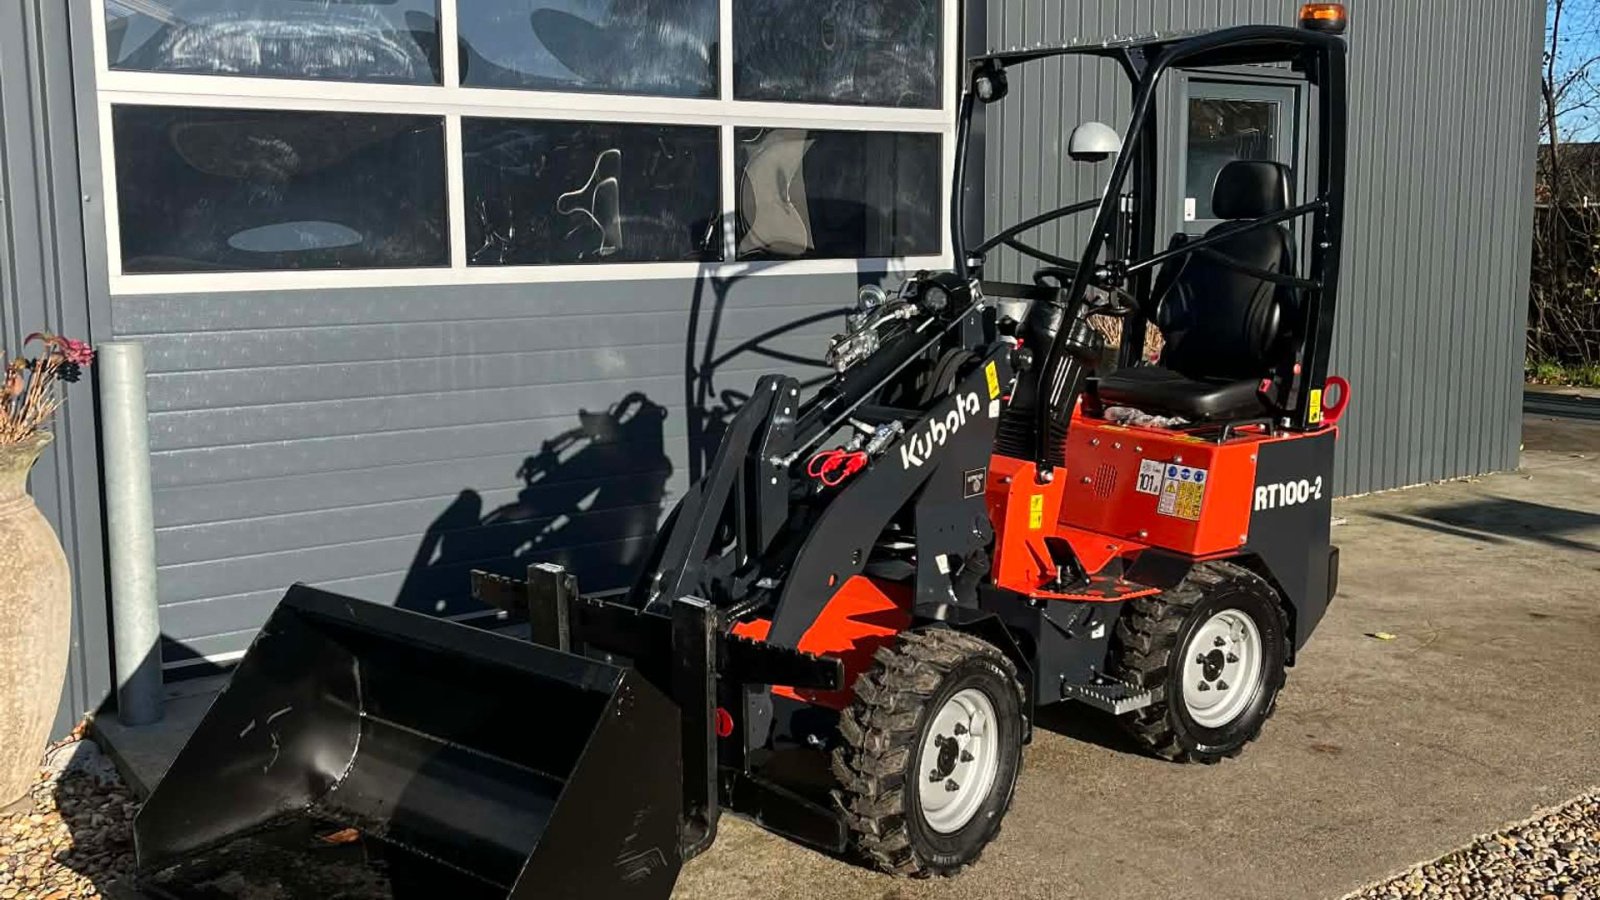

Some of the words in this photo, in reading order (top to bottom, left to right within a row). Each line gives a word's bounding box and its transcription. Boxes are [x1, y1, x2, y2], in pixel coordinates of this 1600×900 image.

[900, 392, 980, 470] Kubota
[1140, 473, 1154, 492] 101
[1254, 475, 1322, 511] RT100-2
